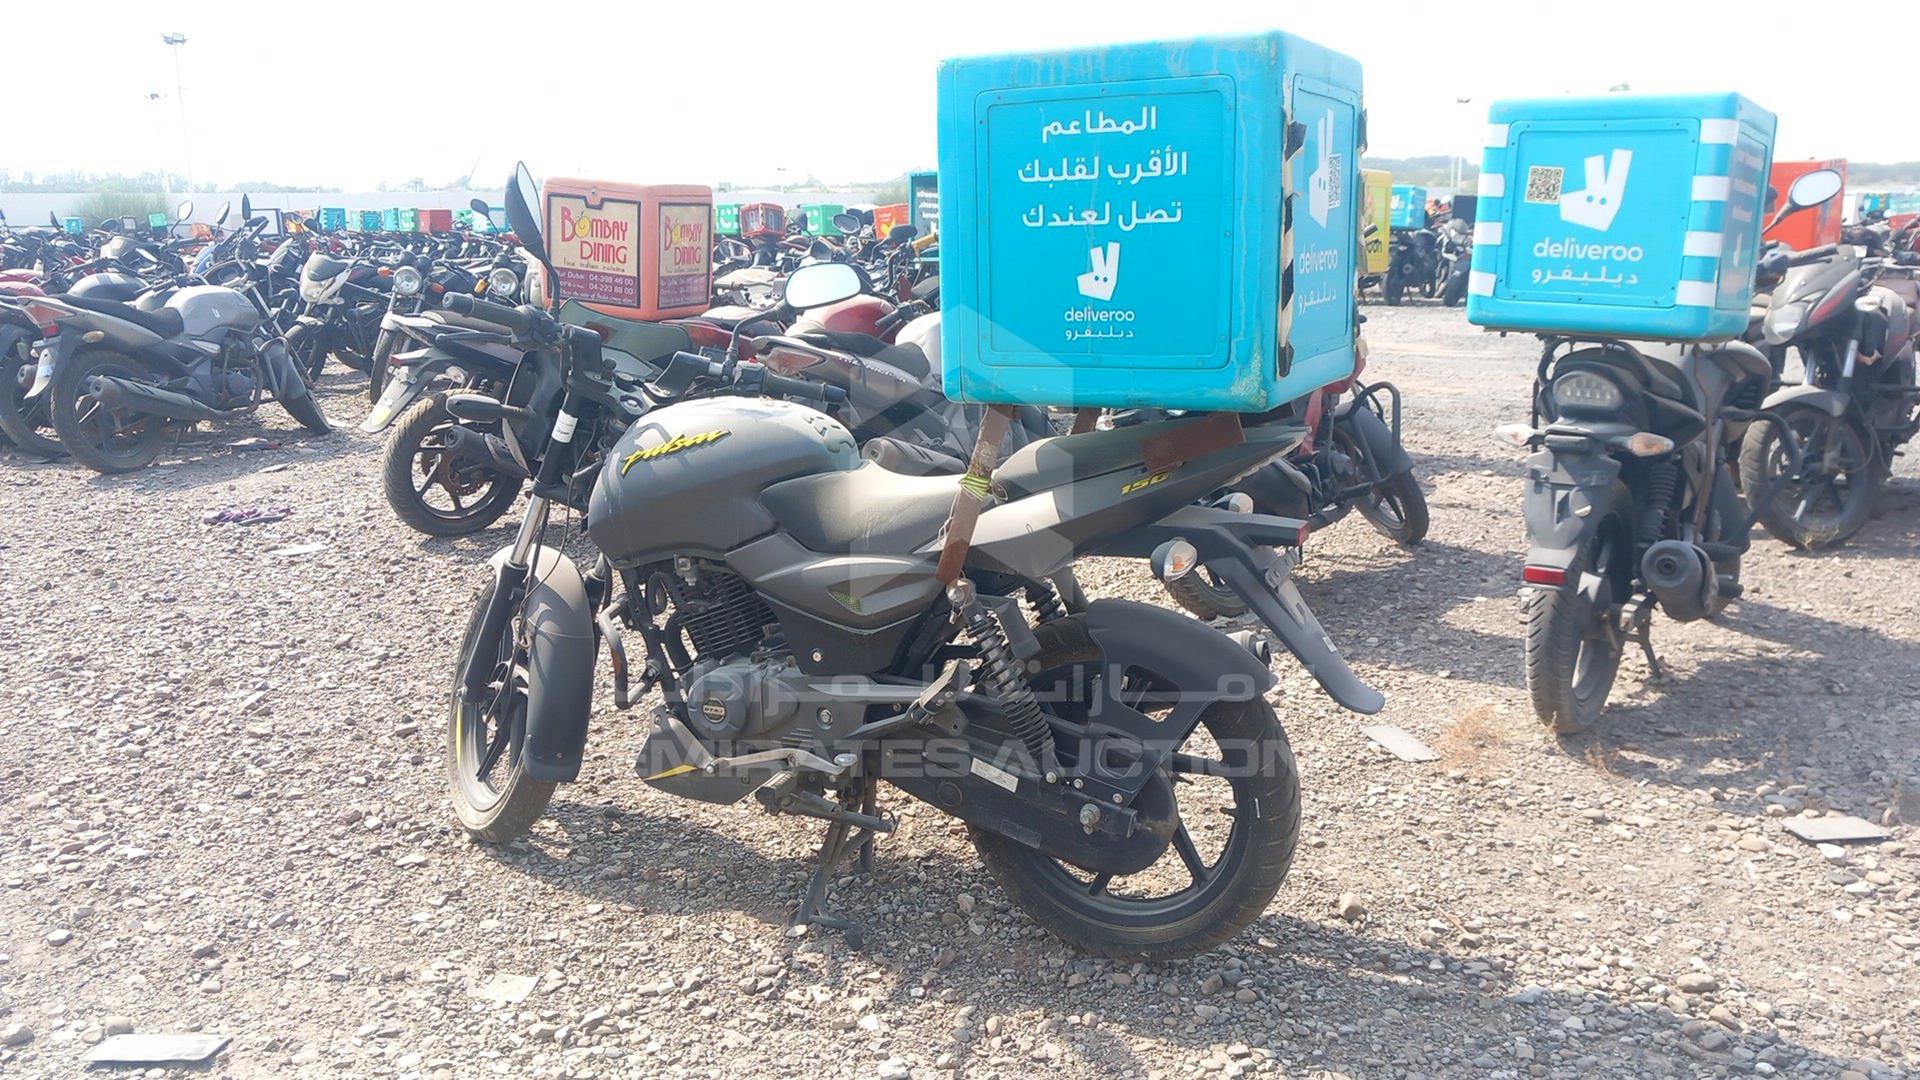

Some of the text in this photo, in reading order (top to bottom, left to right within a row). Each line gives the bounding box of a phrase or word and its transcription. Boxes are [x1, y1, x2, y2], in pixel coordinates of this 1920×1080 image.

[1042, 106, 1157, 144] المطاعم
[1017, 145, 1188, 188] الأقرب لقلبك
[1022, 201, 1183, 231] تصل لعندك
[580, 240, 628, 265] DINING
[1299, 240, 1338, 275] deliveroo
[1533, 236, 1644, 262] deliveroo
[1532, 264, 1639, 288] ديليفرو
[1064, 306, 1135, 322] deliveroo
[1065, 325, 1134, 341] ديليفرو
[1120, 471, 1169, 495] 150
